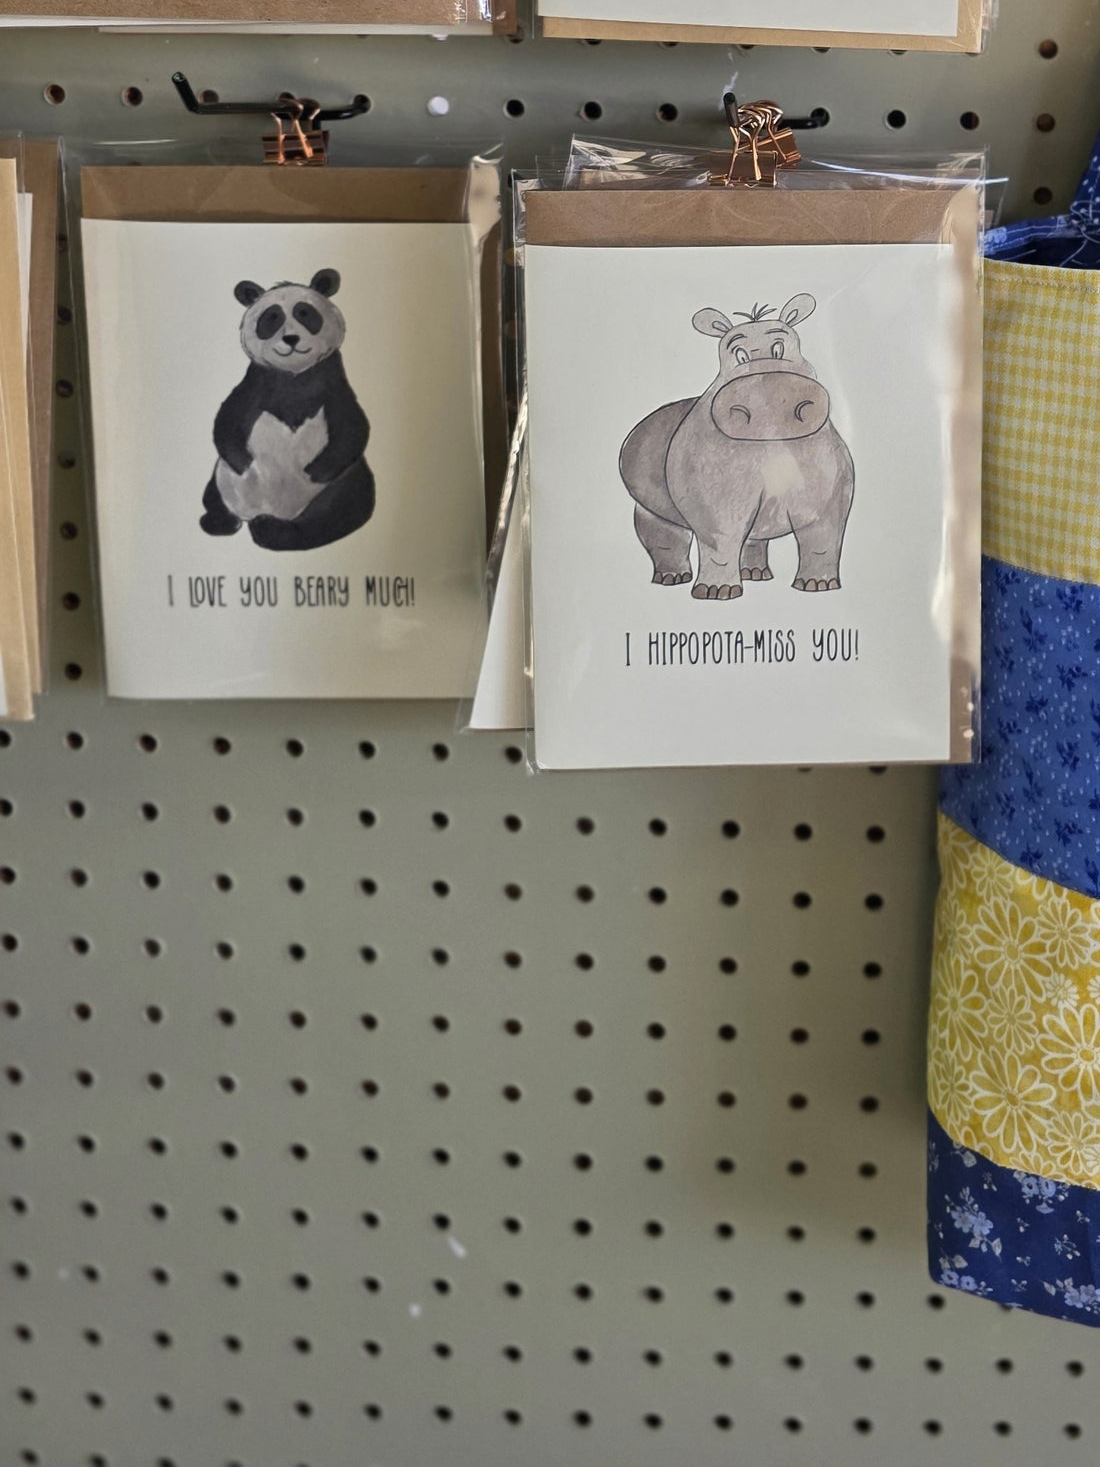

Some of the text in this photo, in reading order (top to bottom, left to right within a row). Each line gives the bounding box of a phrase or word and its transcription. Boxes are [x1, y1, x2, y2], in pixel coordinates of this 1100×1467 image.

[166, 574, 416, 608] I LOVE YOU BEARY MUCH!
[625, 628, 860, 667] I HIPPOPOTA-MISS YOU!
